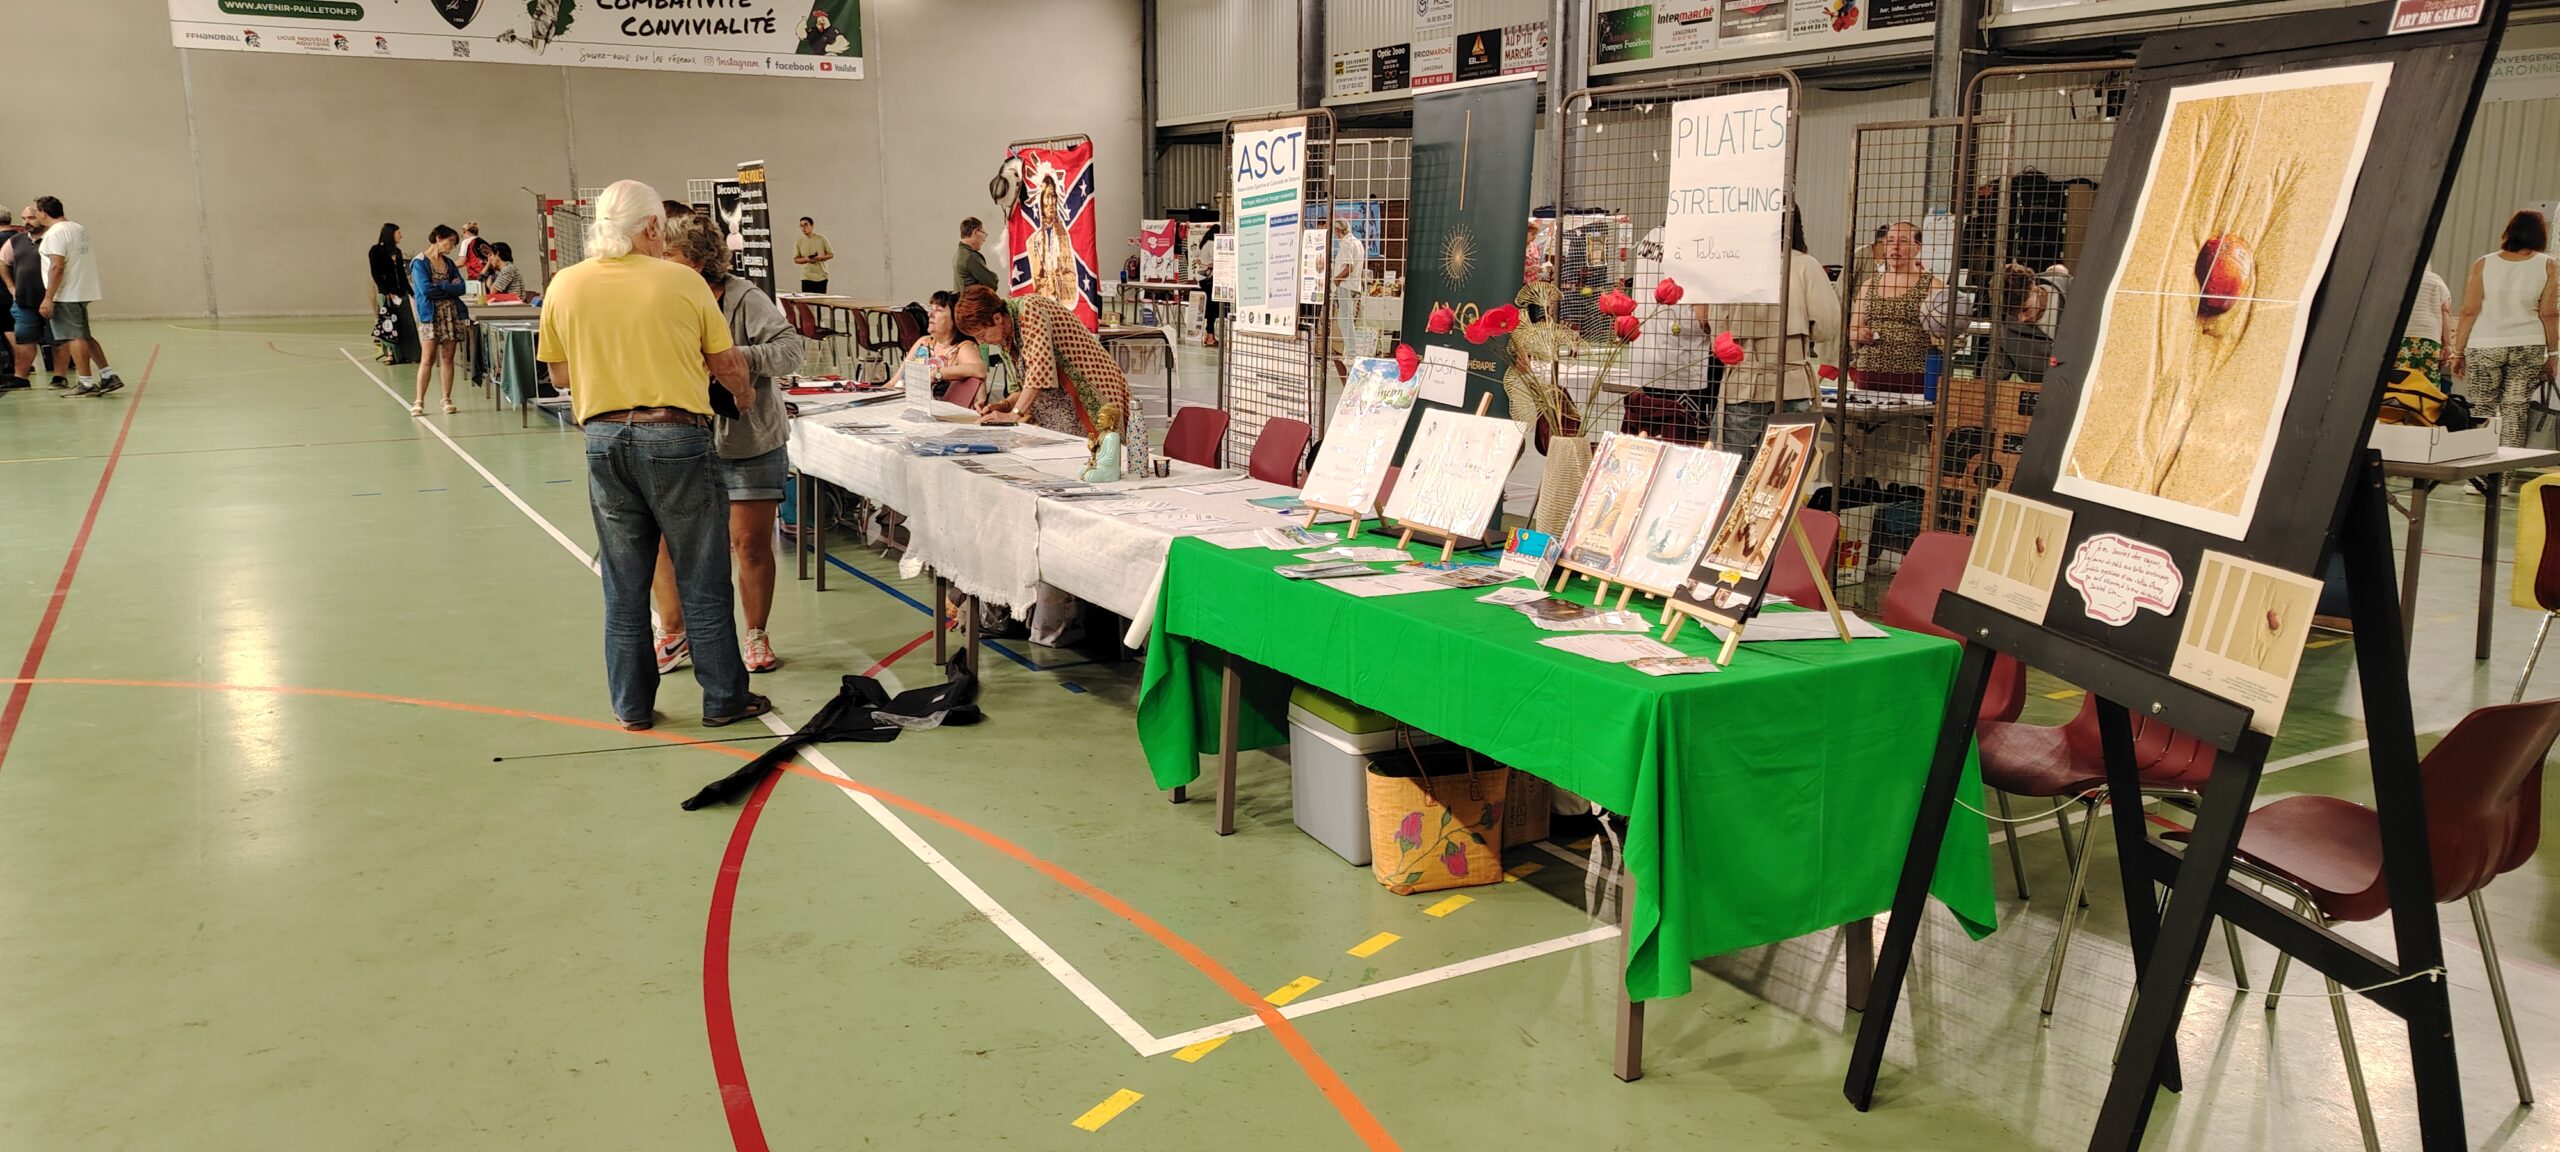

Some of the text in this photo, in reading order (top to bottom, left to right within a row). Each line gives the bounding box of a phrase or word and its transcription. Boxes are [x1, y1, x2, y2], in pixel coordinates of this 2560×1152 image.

[224, 1, 358, 16] WWW.AVENIR-PAILLETON.FR
[1657, 6, 1715, 25] Intermarché
[2397, 13, 2419, 27] ART
[2418, 11, 2435, 25] DE
[2434, 5, 2476, 23] GARAGE
[620, 9, 777, 37] CONVIVIALITÉ
[1376, 47, 1406, 58] Optic 2000
[1504, 45, 1533, 62] MARCHÉ
[1601, 42, 1623, 53] Pompes
[579, 48, 631, 63] Suivez-nous
[635, 54, 649, 63] sur
[652, 51, 664, 64] les
[716, 56, 760, 69] Instagram
[2493, 52, 2560, 64] ONVERGENC
[775, 59, 815, 72] facebook
[834, 64, 857, 73] YouTube
[2488, 62, 2560, 77] ARONNE
[1677, 105, 1785, 159] PILATES
[1237, 132, 1303, 182] ASCT
[717, 184, 740, 195] Découv
[1668, 186, 1781, 216] STRETCHING
[1674, 236, 1742, 260] à Tabanac
[1467, 358, 1497, 372] HÉRAPIE
